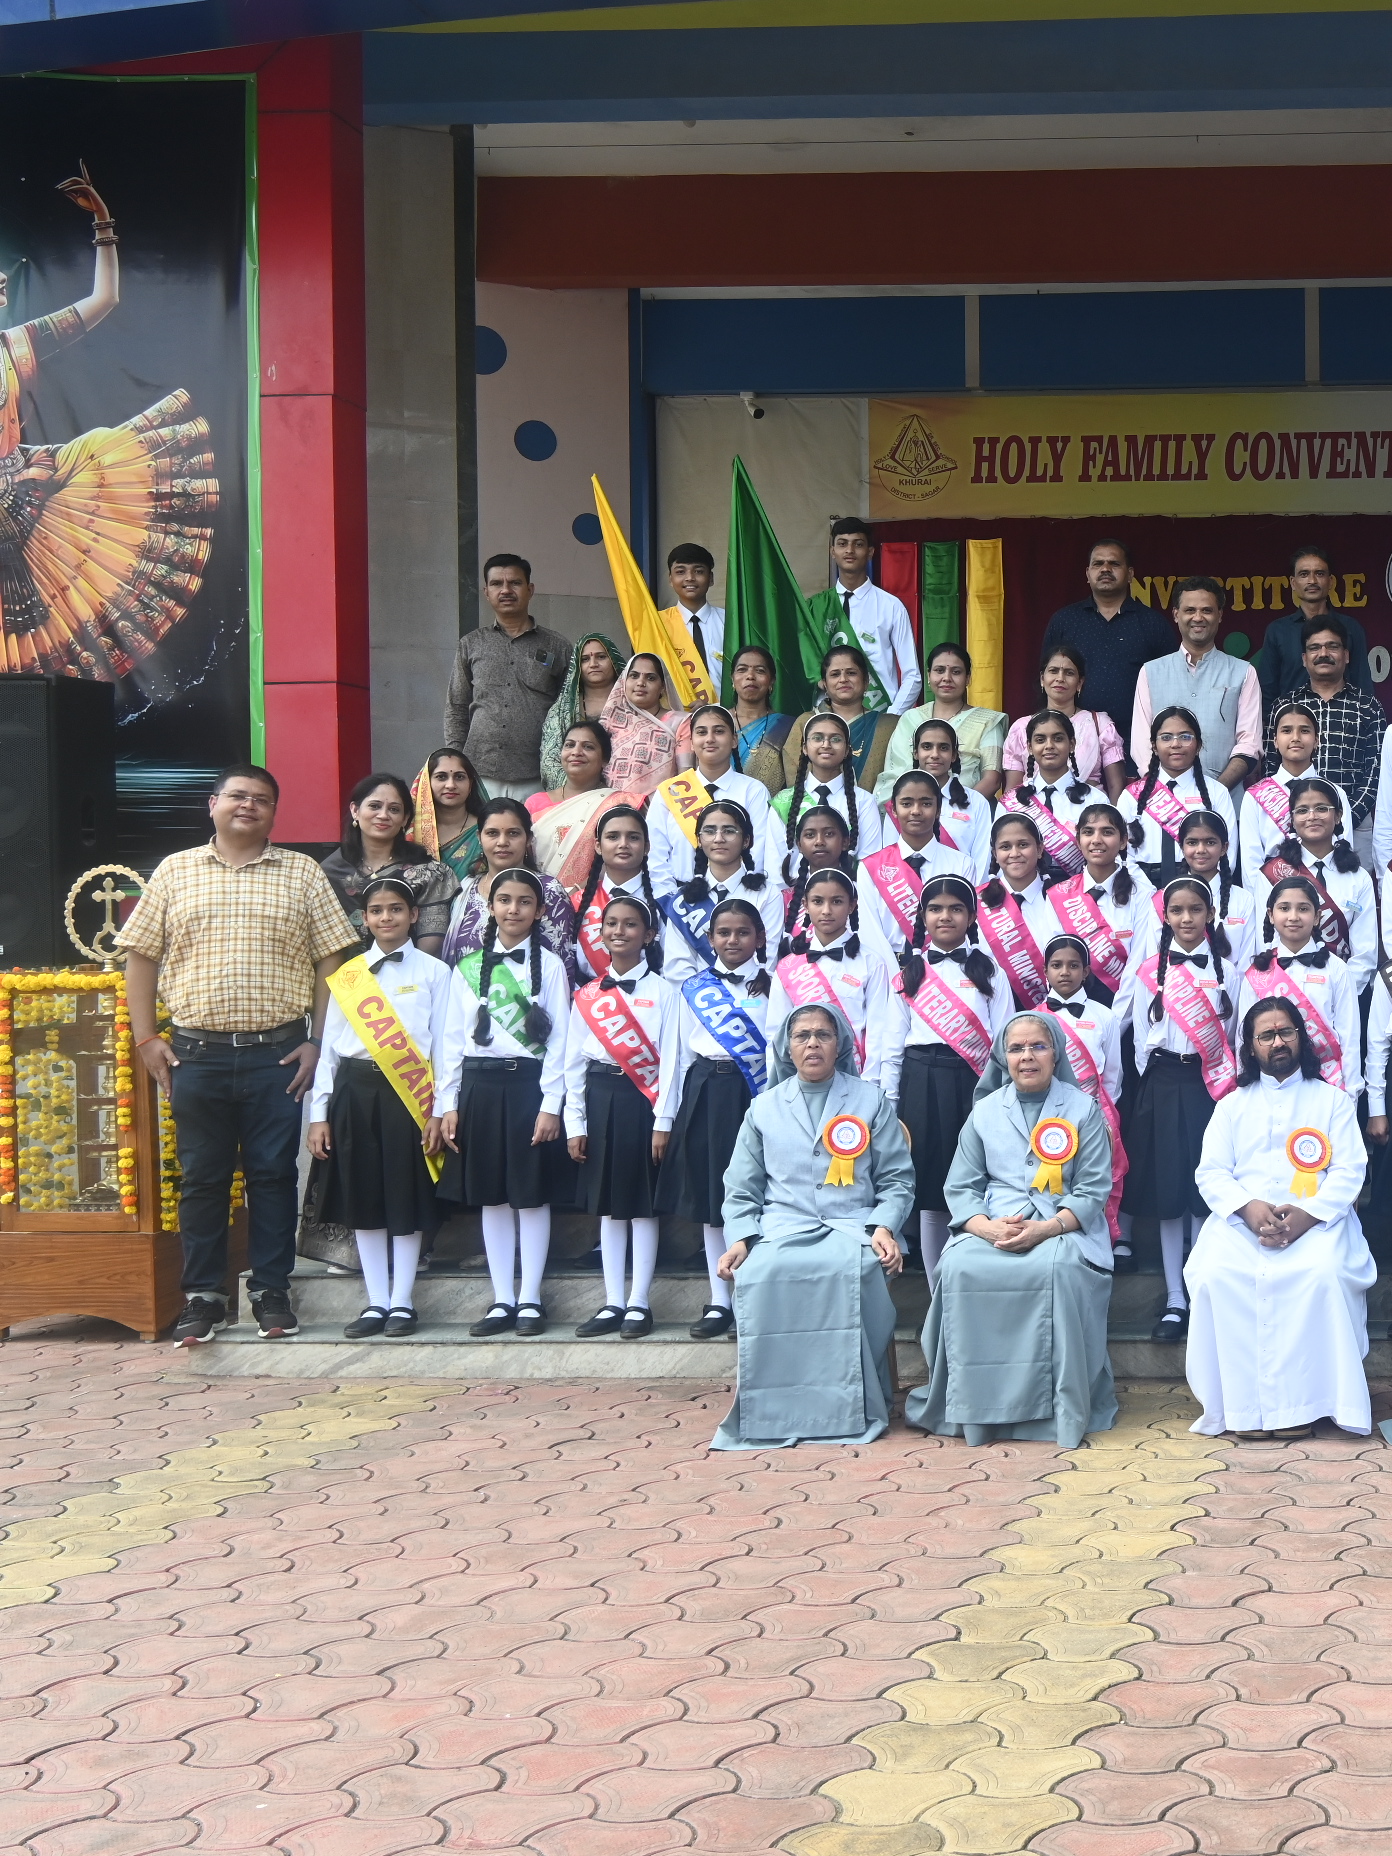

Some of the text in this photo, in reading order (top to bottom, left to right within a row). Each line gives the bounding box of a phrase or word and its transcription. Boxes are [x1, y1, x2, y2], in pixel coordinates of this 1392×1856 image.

[881, 462, 899, 472] LOVE
[927, 463, 948, 473] SERVE
[971, 435, 1071, 485] HOLY
[1078, 433, 1216, 482] FAMILY
[890, 485, 941, 500] DISTRICT SAGAR
[898, 478, 932, 486] KHURAI
[1062, 894, 1111, 967] DISCIPLINE
[788, 963, 832, 1003] SPORT
[1007, 949, 1050, 1006] MINISTE
[1194, 1018, 1237, 1087] MINISTER
